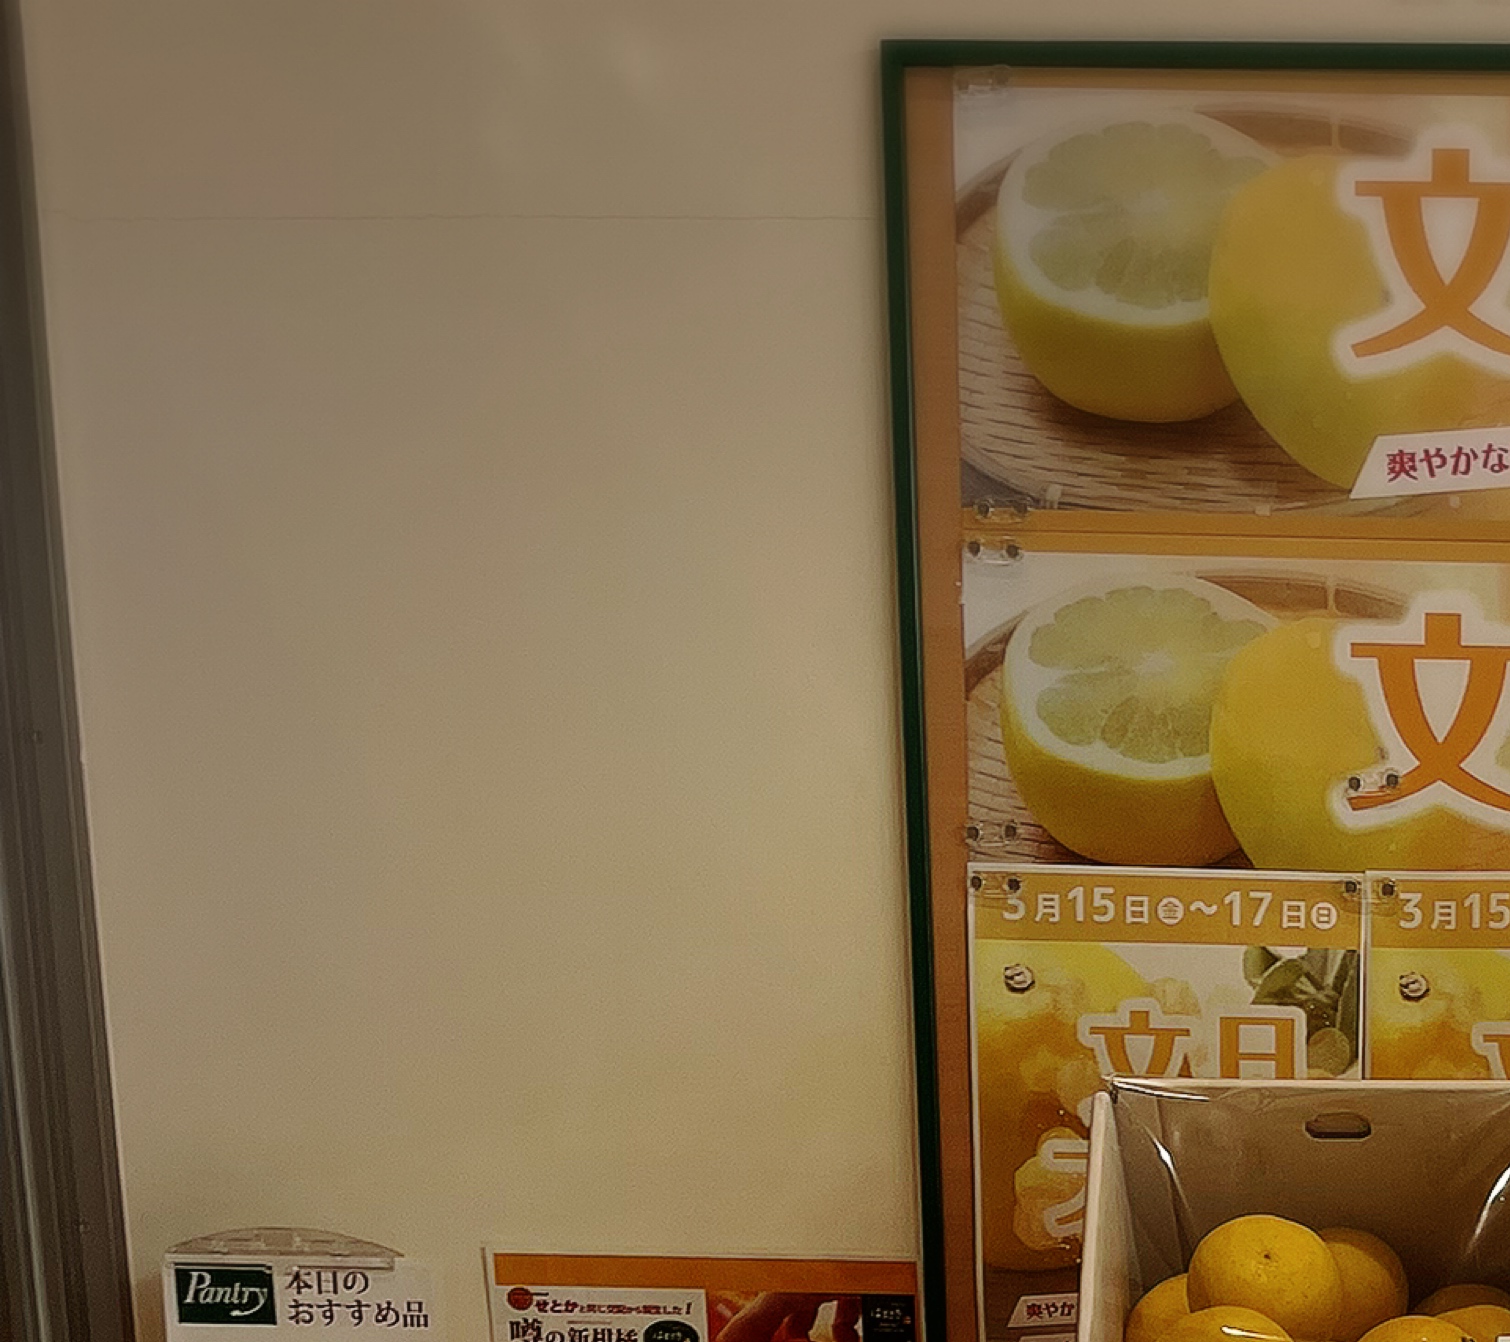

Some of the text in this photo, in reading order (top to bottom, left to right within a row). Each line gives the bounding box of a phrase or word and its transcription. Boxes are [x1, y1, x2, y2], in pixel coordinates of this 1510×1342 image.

[184, 1271, 268, 1317] Pantry
[286, 1270, 370, 1295] 本日の
[287, 1299, 429, 1328] おすすめ品
